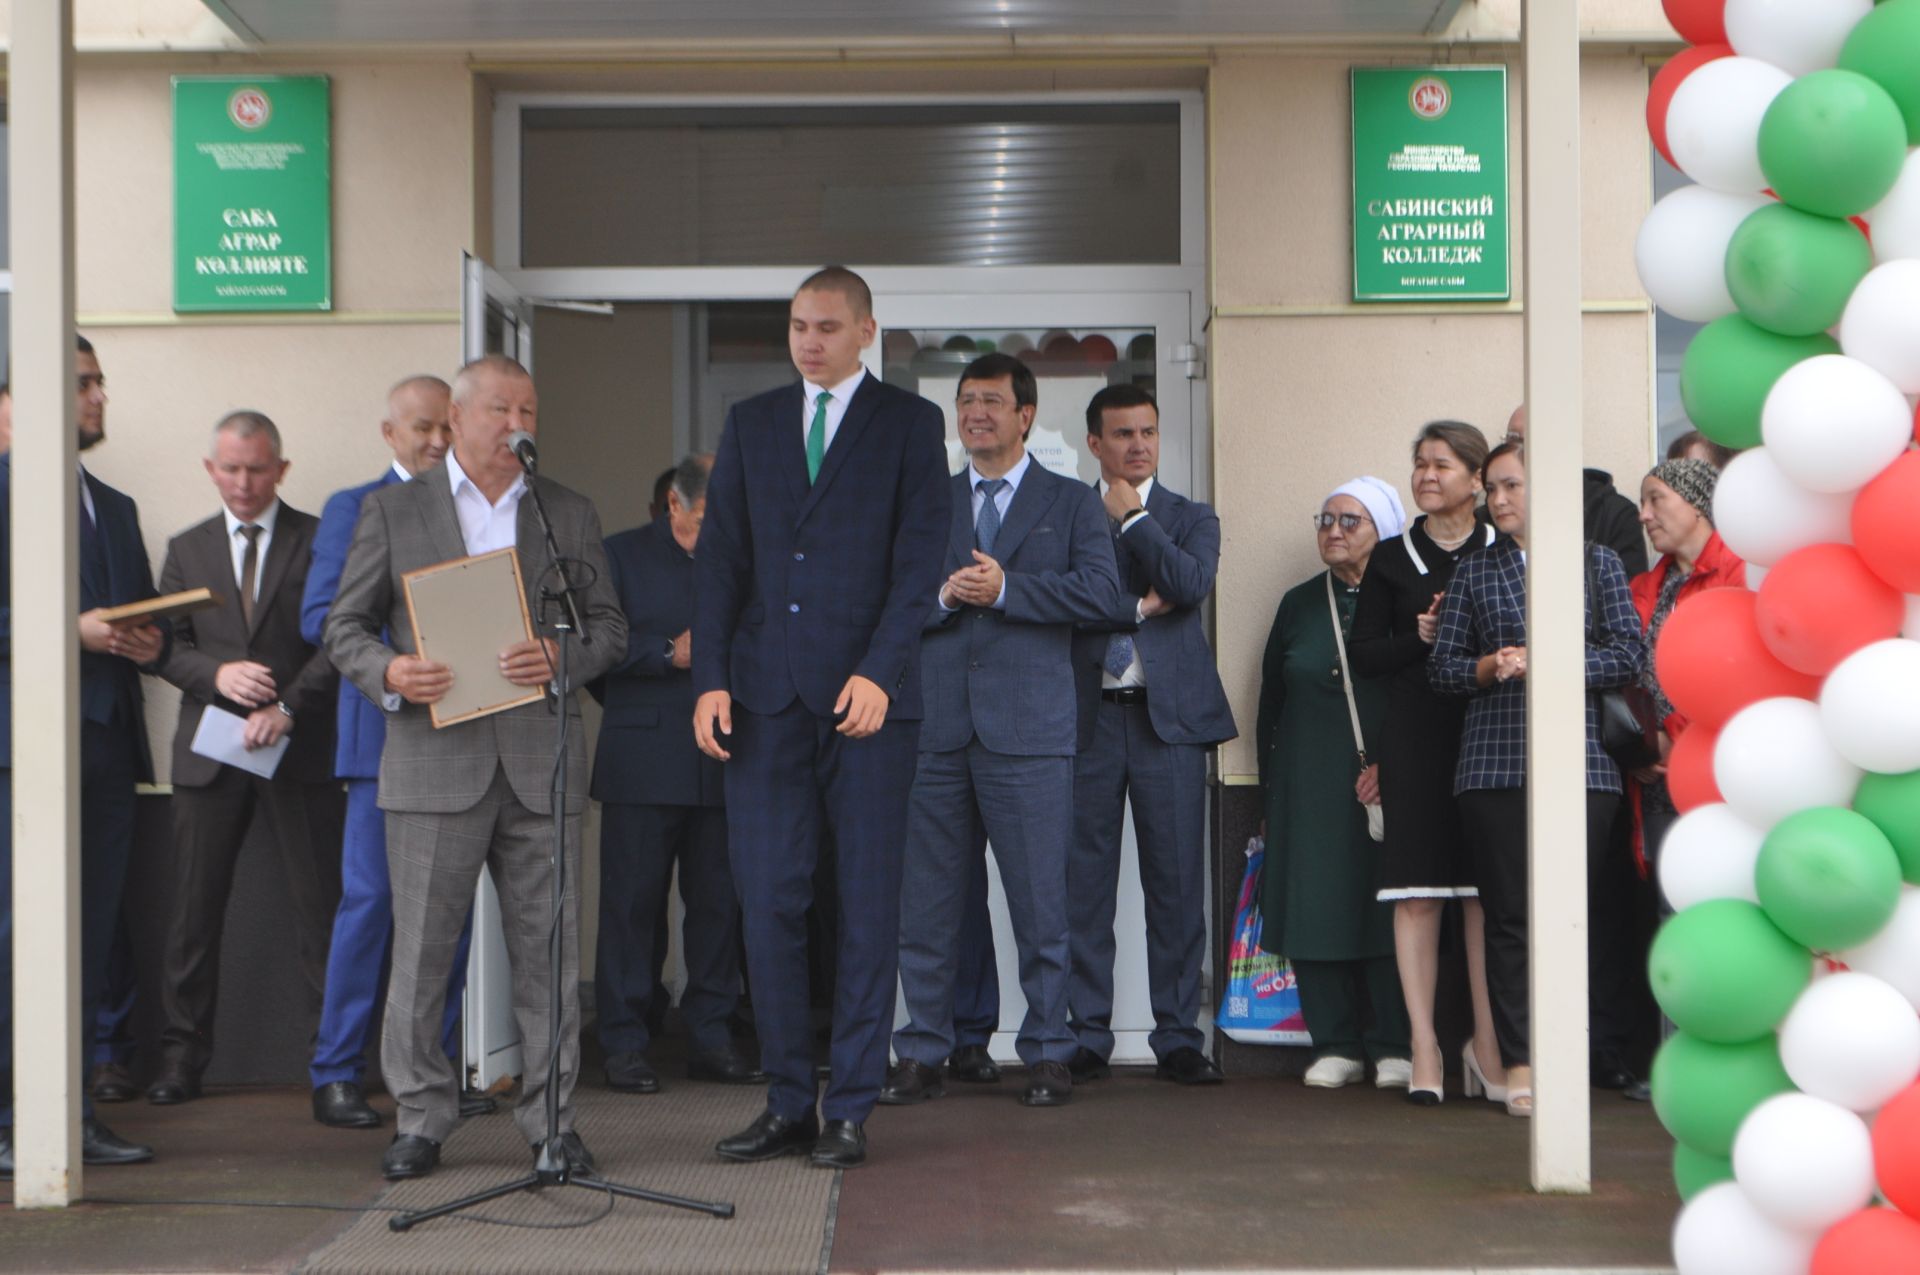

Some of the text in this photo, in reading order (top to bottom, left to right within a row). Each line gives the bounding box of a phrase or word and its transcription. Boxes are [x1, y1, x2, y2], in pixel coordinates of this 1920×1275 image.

[1368, 194, 1493, 217] САБИНСКИЙ
[222, 207, 279, 228] САБА
[1377, 218, 1485, 241] АГРАРНЫЙ
[219, 231, 283, 252] АГРАР
[1382, 245, 1483, 266] КОЛЛЕДЖ
